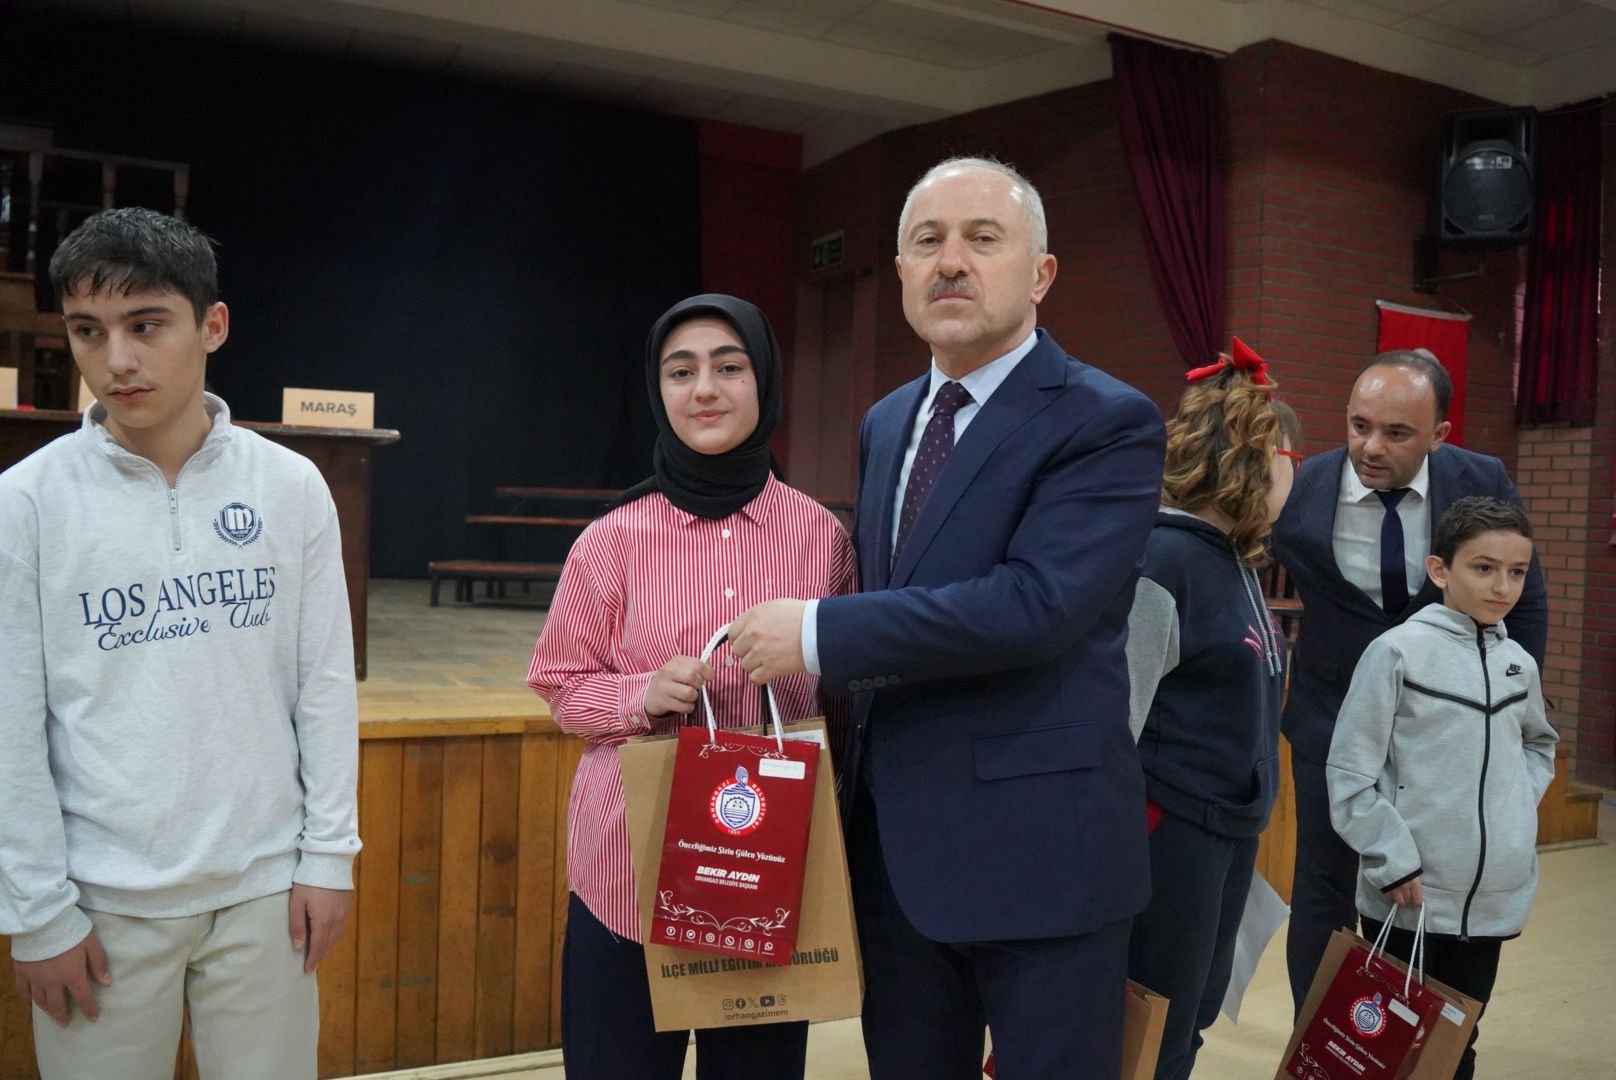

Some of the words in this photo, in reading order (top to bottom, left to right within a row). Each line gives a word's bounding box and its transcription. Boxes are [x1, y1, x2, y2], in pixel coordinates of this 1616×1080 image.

[301, 401, 357, 416] MARAŞ
[79, 583, 146, 626] LOS
[156, 567, 276, 613] ANGELES
[94, 610, 211, 651] Exclusive
[735, 849, 755, 859] Gülen
[756, 852, 786, 863] Yüzünüz
[727, 871, 760, 883] AYDIN
[661, 963, 687, 979] İLÇE
[688, 959, 720, 977] MİLLİ
